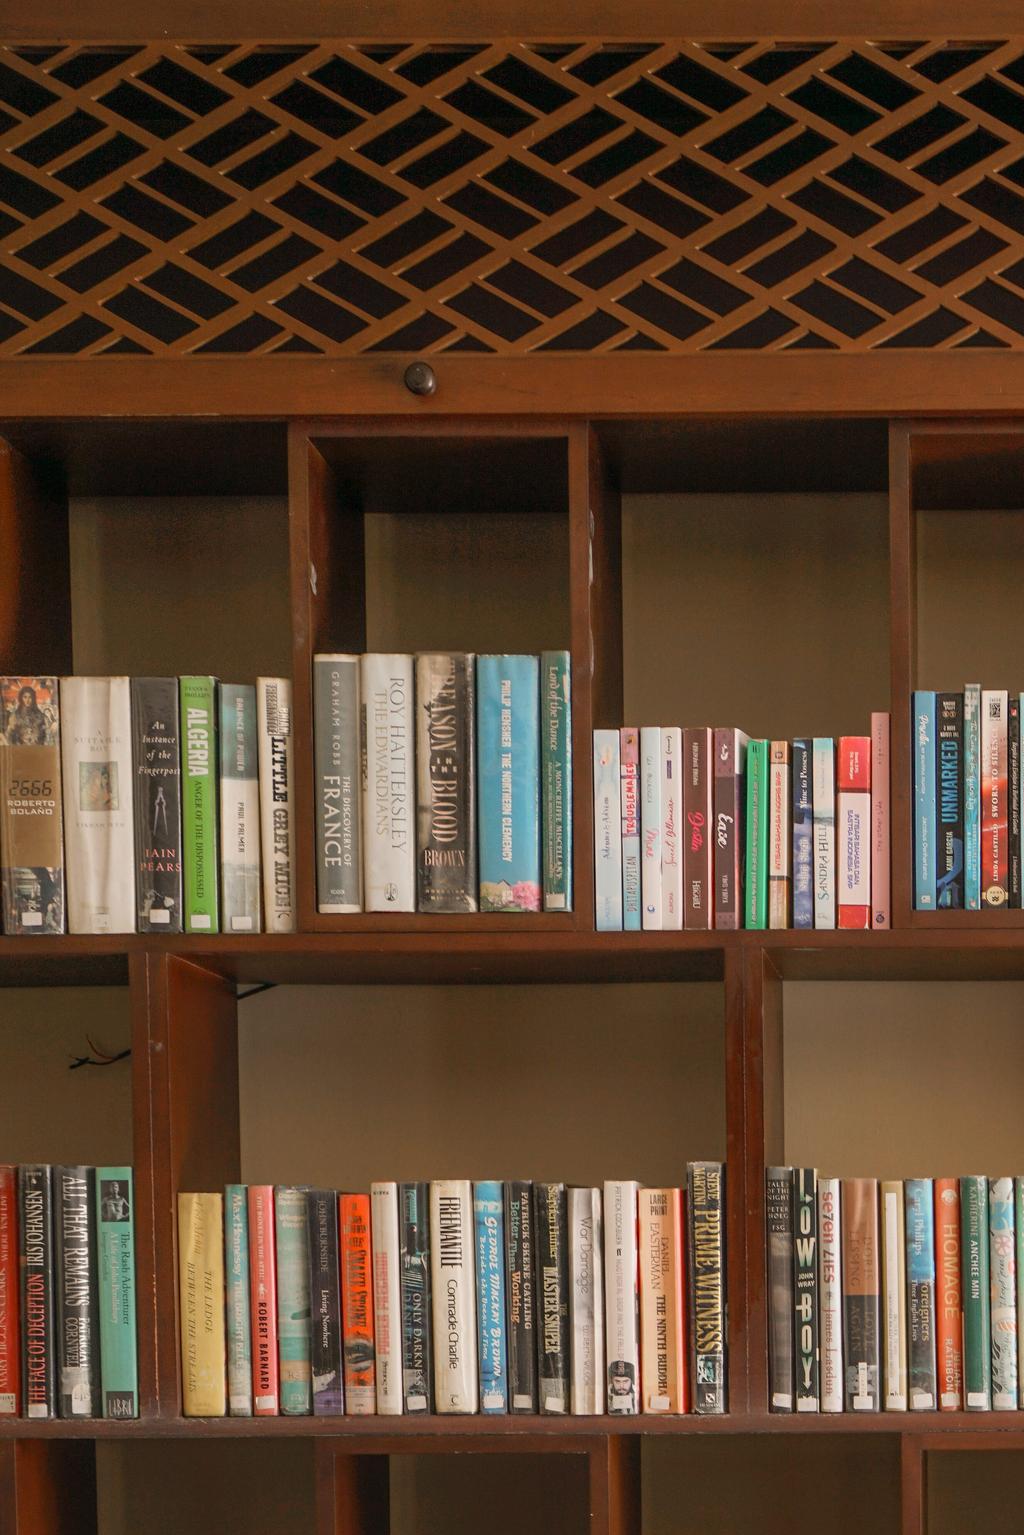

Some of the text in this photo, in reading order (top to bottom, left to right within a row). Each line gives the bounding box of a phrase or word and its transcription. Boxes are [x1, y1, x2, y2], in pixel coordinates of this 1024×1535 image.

[142, 734, 175, 744] Instance
[152, 721, 165, 730] An
[187, 708, 208, 776] ALGERIA
[548, 667, 562, 751] Lord of the Dance
[9, 780, 52, 796] 2666
[146, 750, 171, 760] of the
[374, 690, 388, 835] THE EDWARDIANS
[390, 678, 407, 854] ROY HATTERSLEY
[941, 741, 958, 822] UNMARKED
[10, 807, 53, 815] BOLAÑO
[145, 849, 175, 858] IAIN
[196, 811, 203, 820] OF
[272, 738, 291, 908] LITTLE GREY MICE
[324, 776, 342, 867] FRANCE
[343, 776, 352, 867] THE DISCOVERY OF
[141, 863, 181, 872] PEARS
[196, 843, 204, 898] DISPOSSESSED
[63, 1176, 90, 1305] ALL THAT REMAINS
[439, 1197, 462, 1268] FREEMANTLE
[508, 1201, 521, 1323] Better Than Working
[521, 1192, 532, 1329] PATRICK SKENE CATLING
[943, 1224, 958, 1319] HOMAGE
[970, 1186, 979, 1298] KATHERINE ANCHEE MIN
[121, 1232, 131, 1325] The Rash Adventurer
[321, 1290, 330, 1347] Living Nowhere
[543, 1266, 560, 1353] MASTER SNIPER
[695, 1209, 722, 1354] PRIME WITNESS
[258, 1302, 269, 1389] ROBERT BARNARD
[448, 1280, 458, 1369] Comrade Charlie
[656, 1295, 668, 1396] THE NINTH BUDDHA
[825, 1308, 837, 1394] James Lasdun
